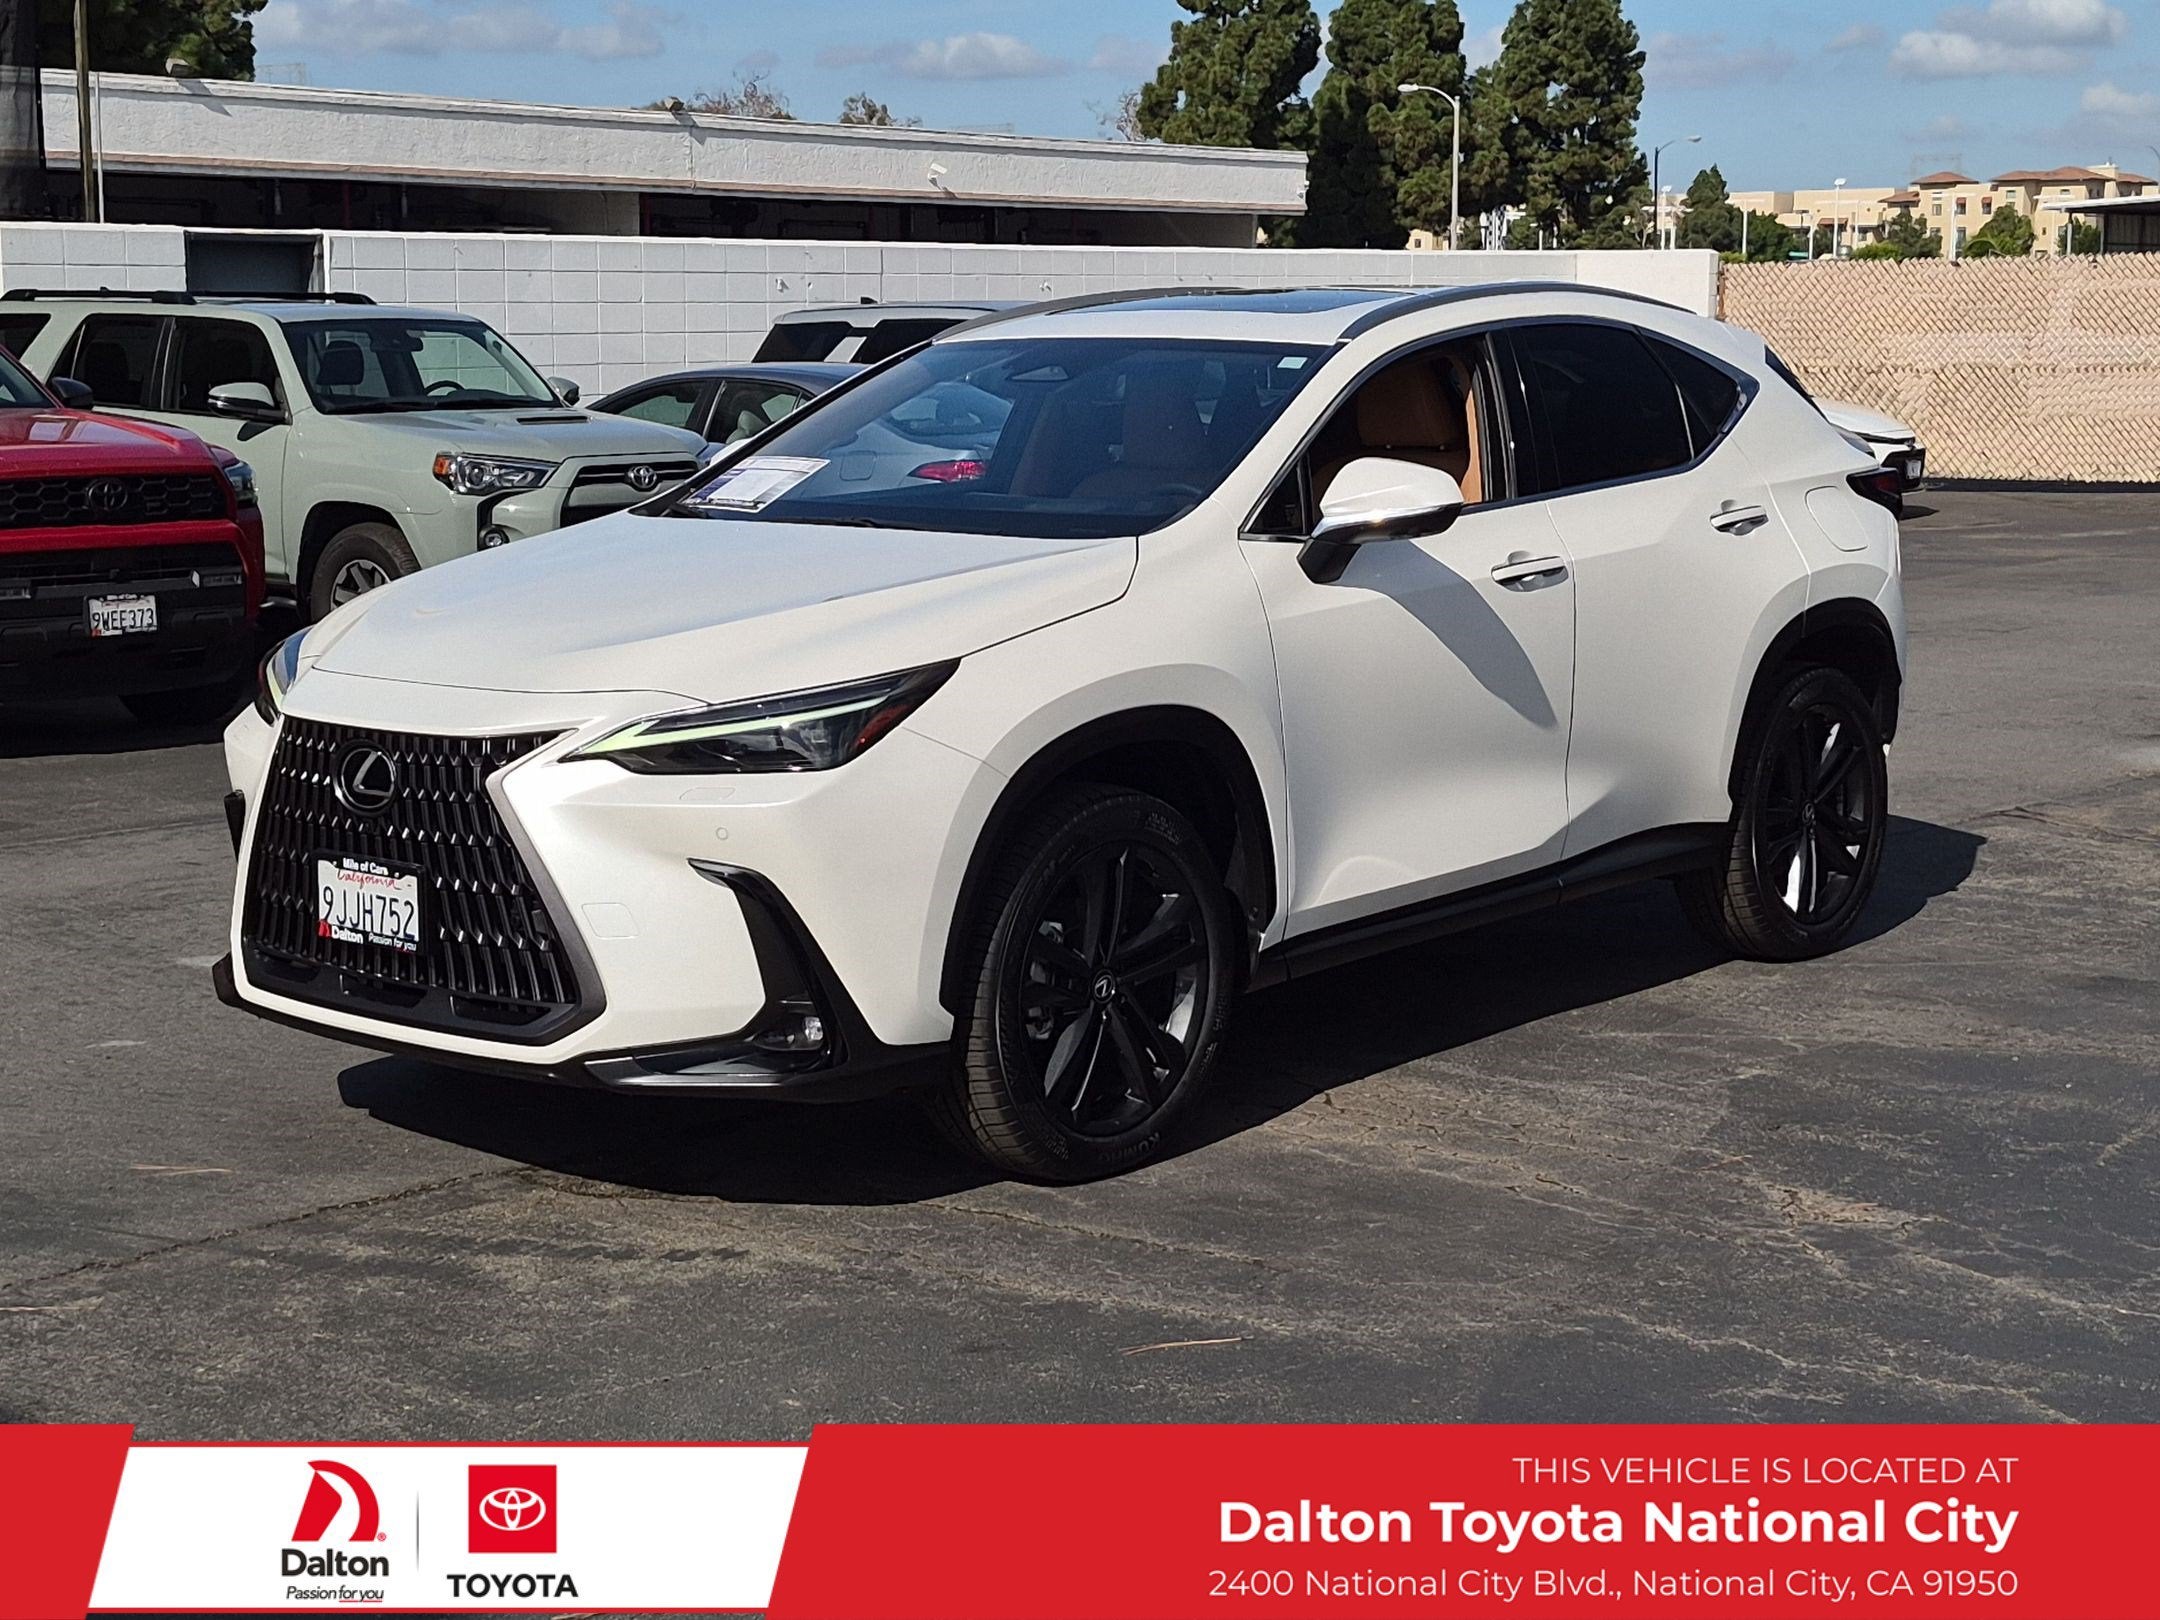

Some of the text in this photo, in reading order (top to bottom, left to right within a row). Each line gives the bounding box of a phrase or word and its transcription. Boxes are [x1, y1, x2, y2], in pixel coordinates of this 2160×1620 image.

[92, 608, 154, 631] 9WEE373
[342, 857, 359, 870] Mile
[360, 861, 369, 872] of
[337, 869, 401, 890] California
[323, 886, 415, 940] 9JJH752
[331, 925, 364, 944] Dalton
